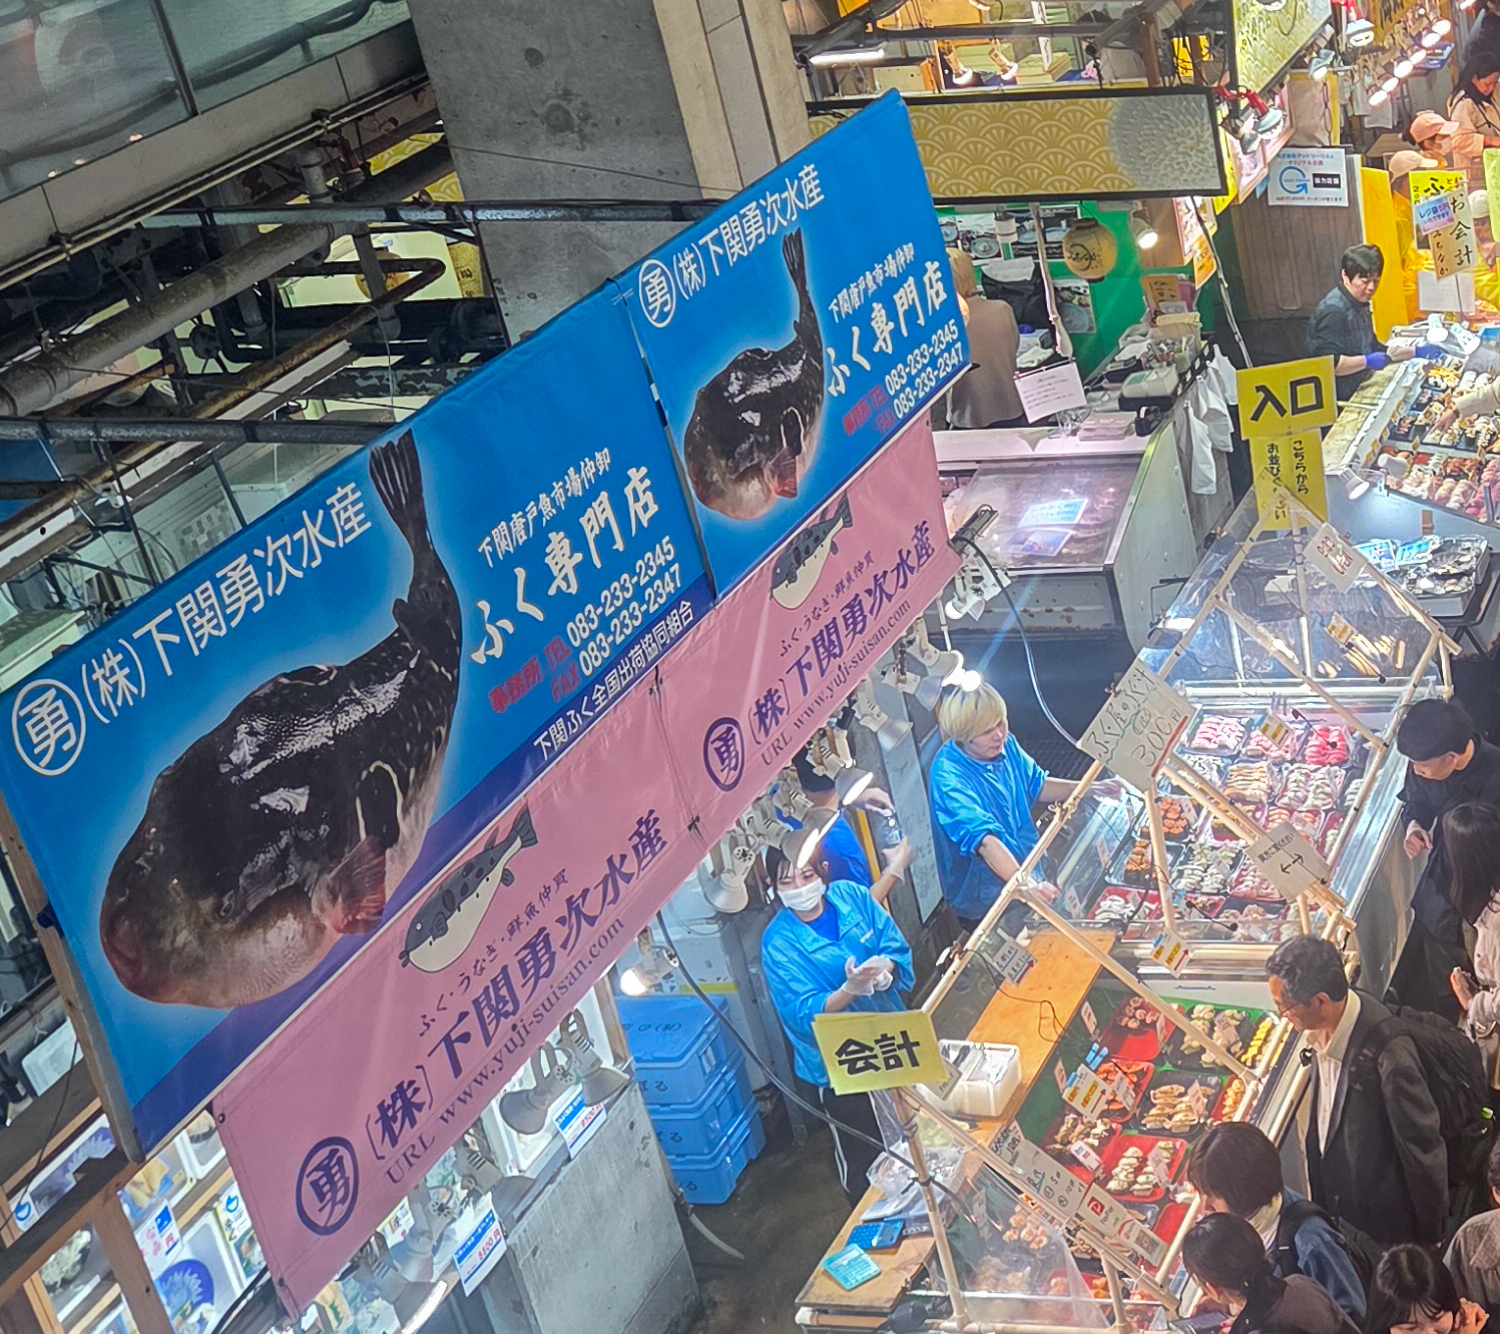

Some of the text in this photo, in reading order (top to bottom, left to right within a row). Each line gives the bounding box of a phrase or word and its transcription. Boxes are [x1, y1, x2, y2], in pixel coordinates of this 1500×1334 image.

[1450, 192, 1474, 267] お会計
[826, 261, 947, 397] ふく専門店
[885, 319, 959, 396] 083-233-2345
[893, 341, 964, 419] 083-233-2347
[1250, 375, 1324, 422] 入口
[1293, 441, 1309, 495] こちらから
[81, 481, 372, 724] (株)下関勇次水産
[470, 465, 659, 665] ふく専門店
[566, 535, 675, 647] 083-233-2345
[579, 563, 683, 677] 083-233-2347
[16, 682, 81, 773] 勇
[533, 600, 693, 760] 下関ふく全国出荷協同組合
[760, 600, 912, 766] URL www.yuji-suisan.com
[386, 916, 626, 1185] URL www.yuji-suisan.com
[835, 1030, 922, 1076] 会計
[301, 1142, 355, 1231] 勇
